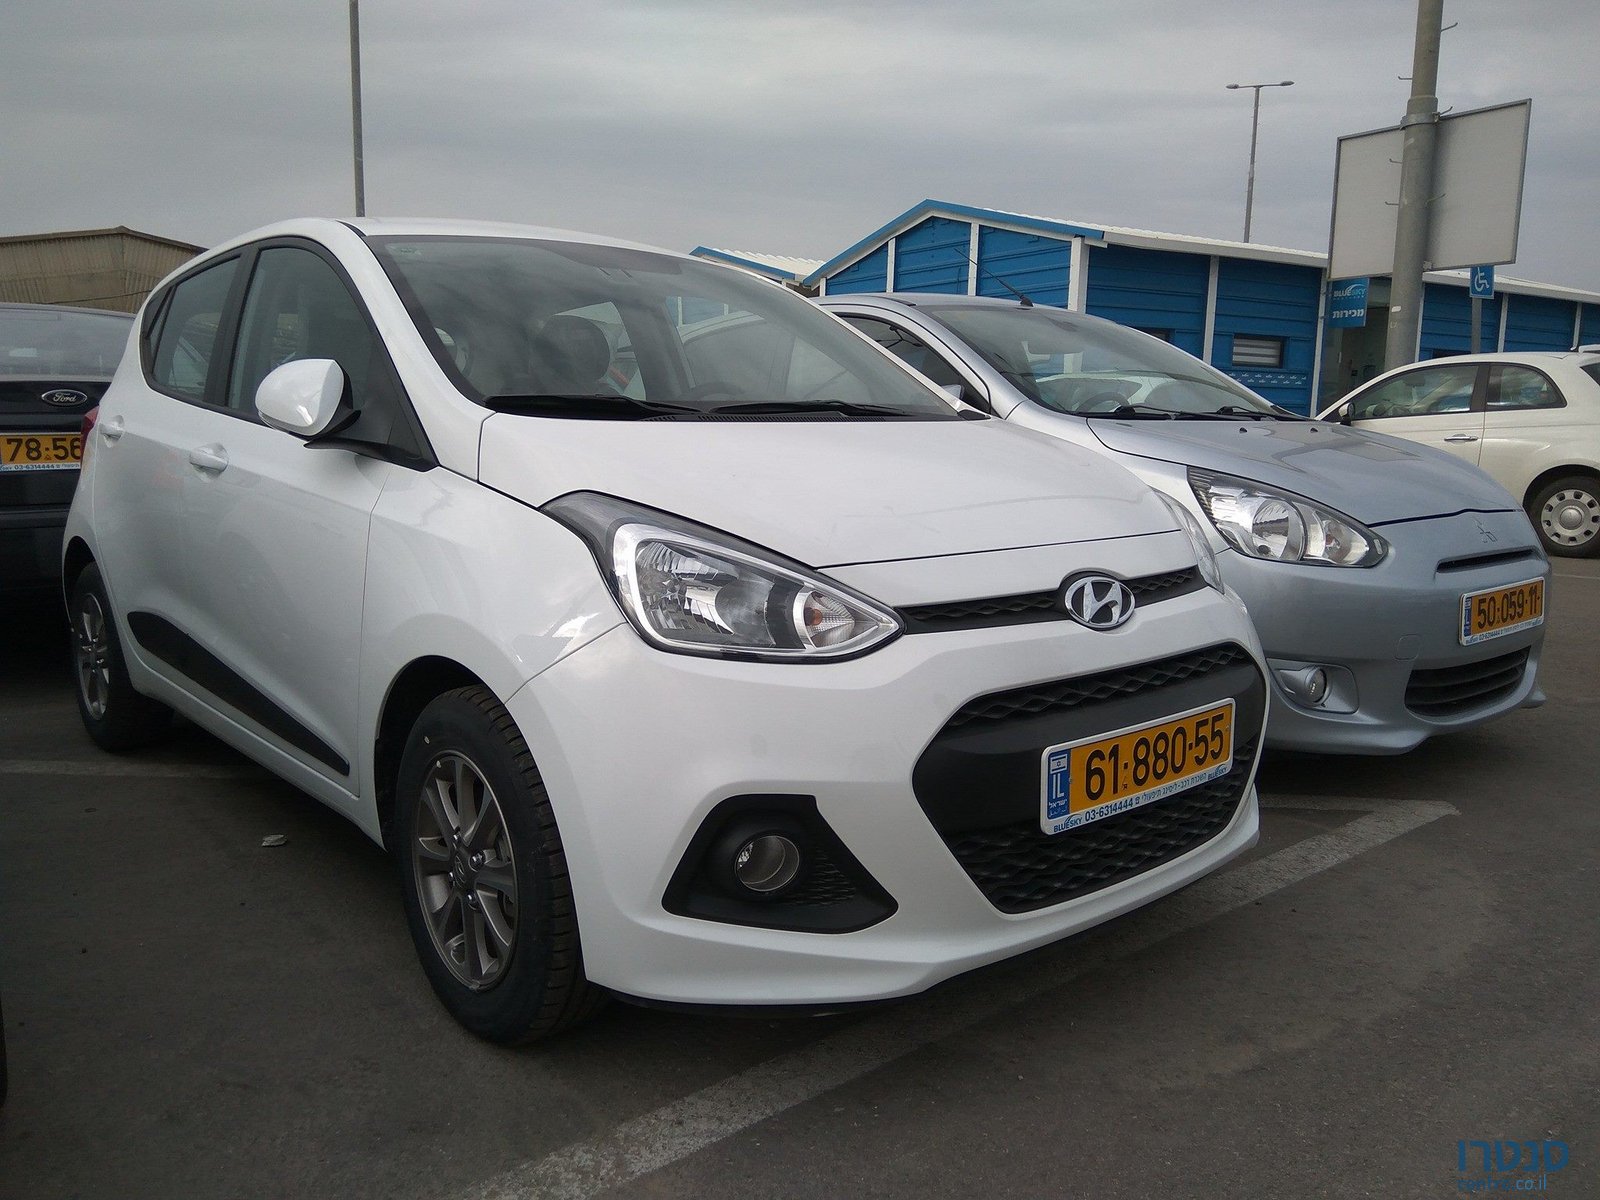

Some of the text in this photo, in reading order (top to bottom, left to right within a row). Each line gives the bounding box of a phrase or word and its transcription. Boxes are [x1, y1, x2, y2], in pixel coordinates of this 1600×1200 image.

[1332, 308, 1365, 319] מכירות
[53, 393, 77, 402] Ford
[1052, 772, 1065, 800] IL
[1053, 814, 1083, 833] BLUESKY
[1084, 797, 1134, 823] 03-6314444
